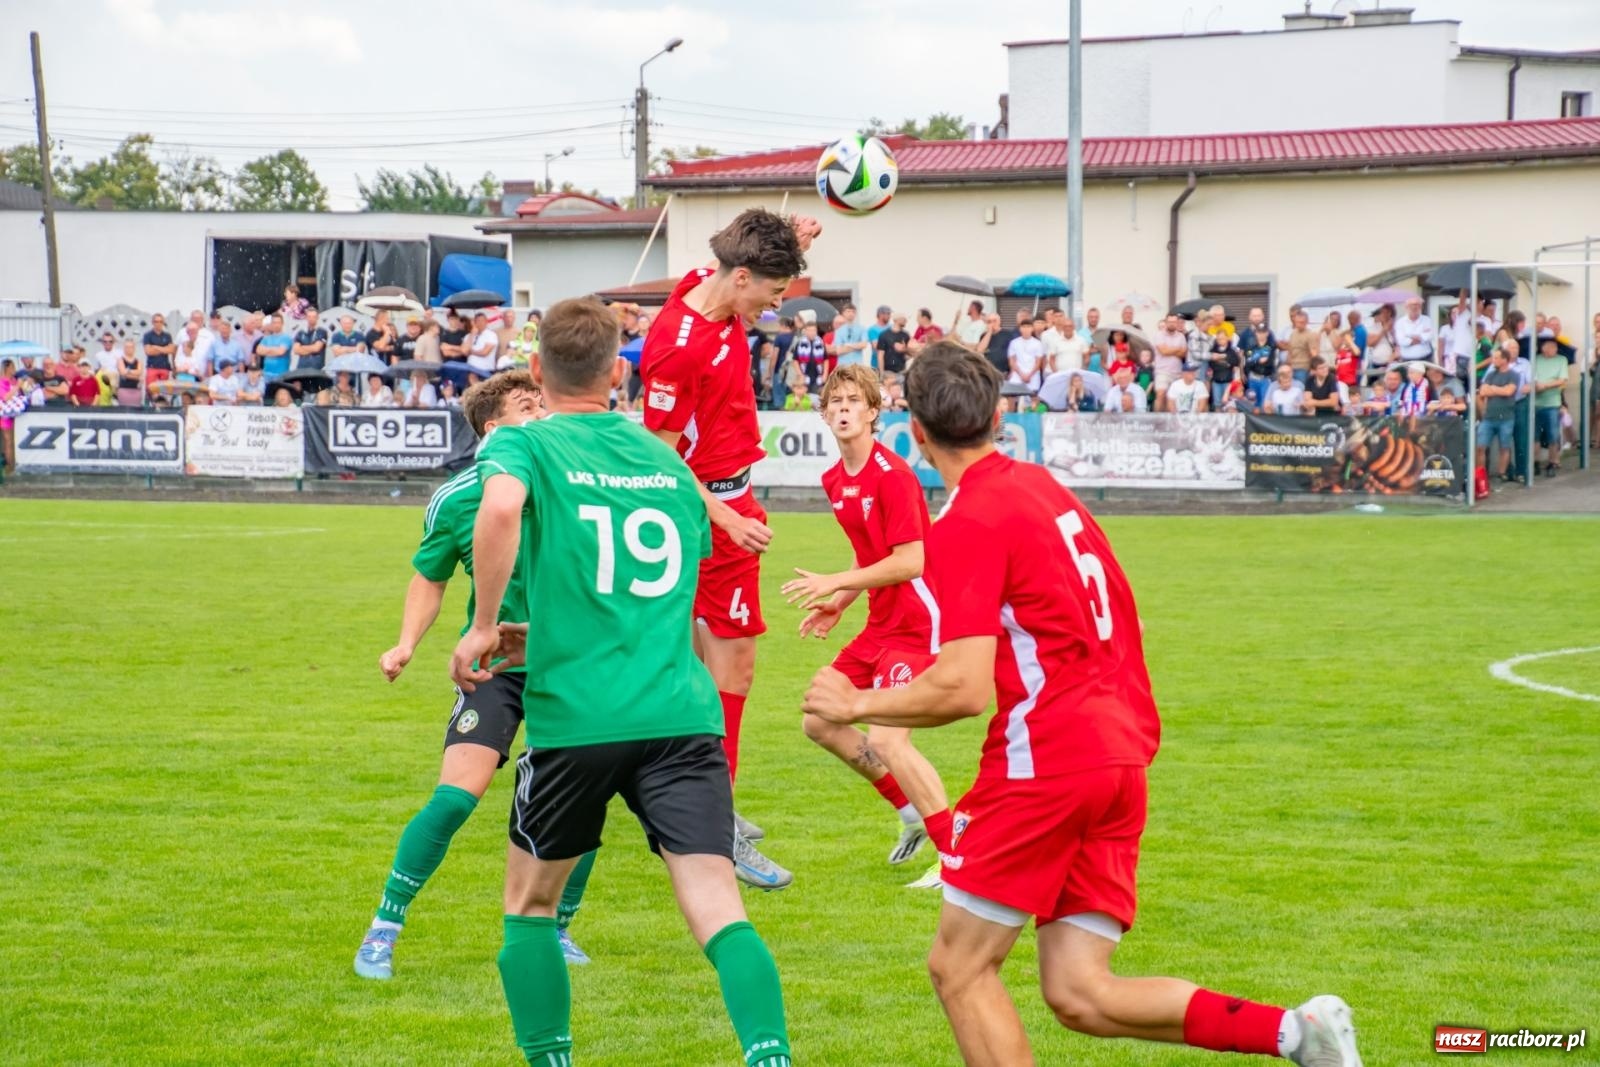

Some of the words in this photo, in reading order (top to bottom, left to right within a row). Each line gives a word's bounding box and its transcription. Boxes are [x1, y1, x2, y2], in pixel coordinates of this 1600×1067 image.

[71, 428, 177, 451] zina
[247, 439, 270, 450] Lody
[1250, 432, 1292, 444] ODKRYJ
[1294, 434, 1326, 445] SMAK
[336, 454, 444, 469] www.sklep.keeza.pl
[567, 471, 596, 486] LKS
[597, 472, 678, 490] TWORKÓW
[711, 481, 734, 490] PRO
[578, 503, 682, 598] 19
[1055, 509, 1113, 641] 5
[729, 587, 750, 626] 4
